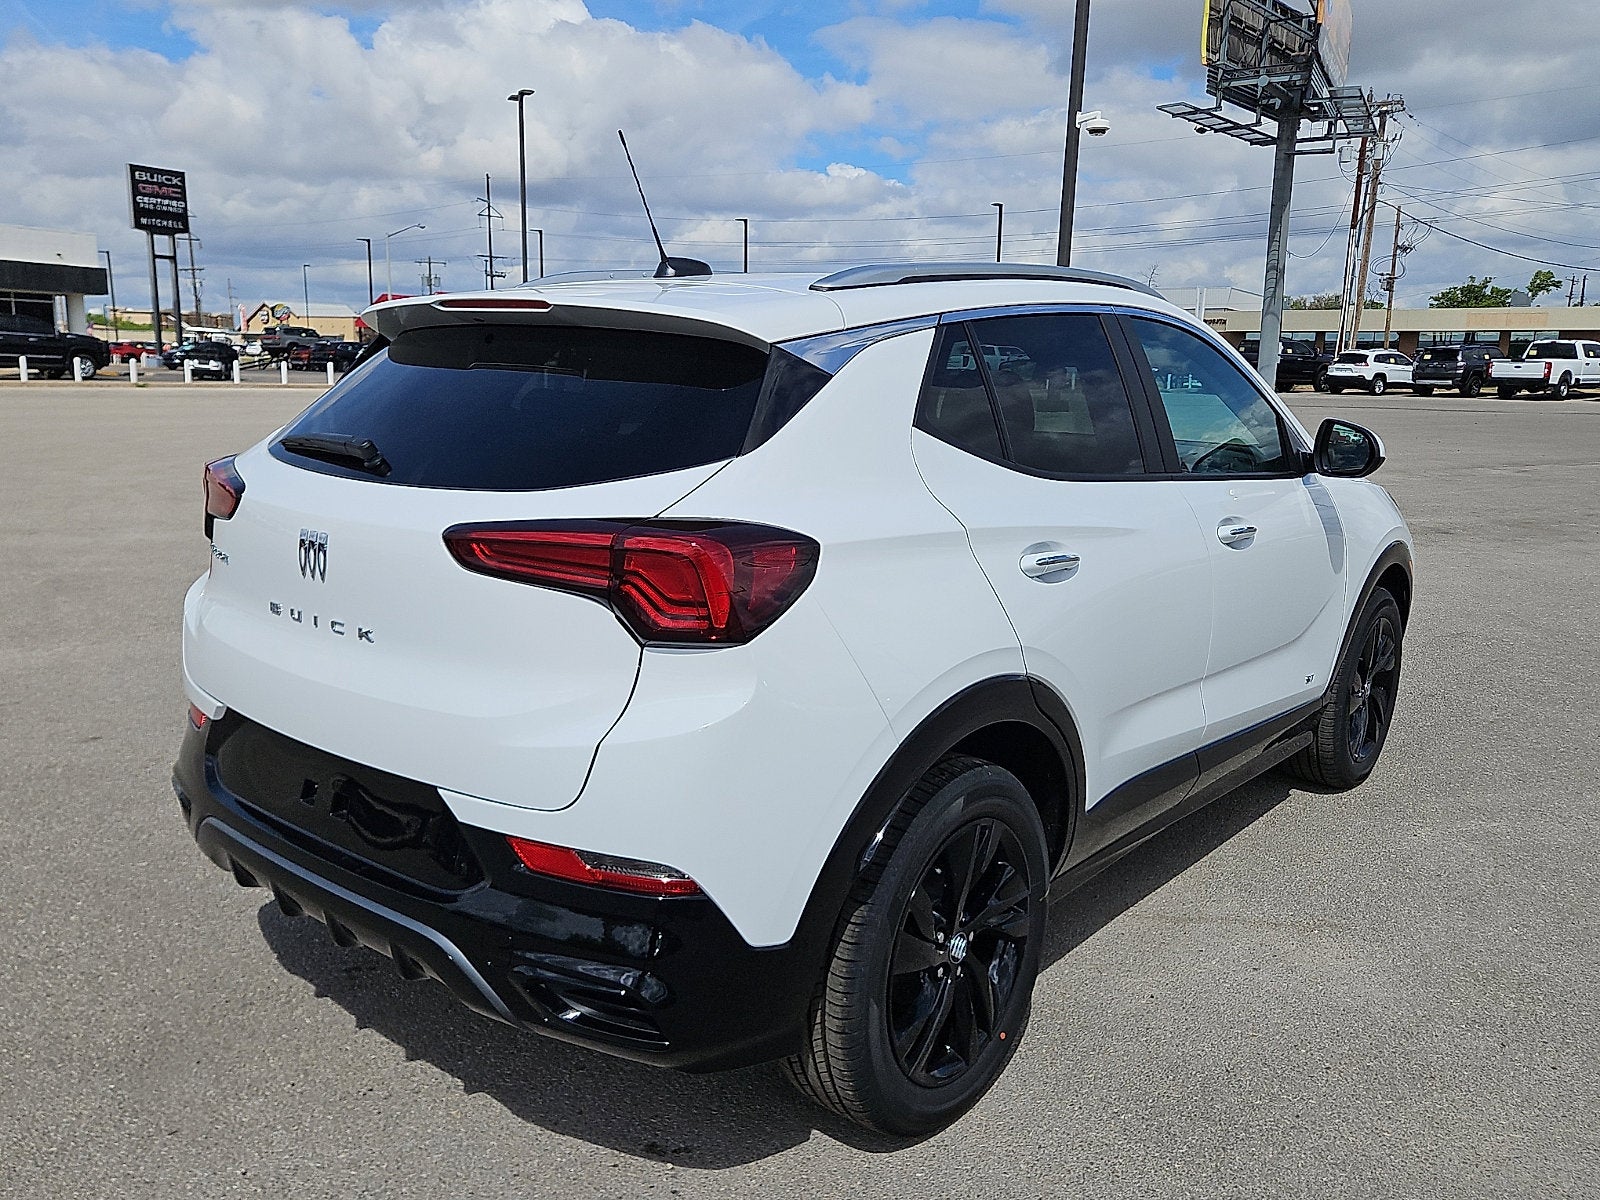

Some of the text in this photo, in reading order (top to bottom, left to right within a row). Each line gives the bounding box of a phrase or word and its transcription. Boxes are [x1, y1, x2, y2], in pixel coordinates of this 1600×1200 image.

[135, 171, 182, 185] BUICK
[138, 184, 181, 197] GMC
[136, 196, 185, 207] CERTIFIED
[140, 203, 183, 213] PRE-OWNED
[141, 217, 184, 228] MITCHELL
[269, 601, 375, 644] BUICK
